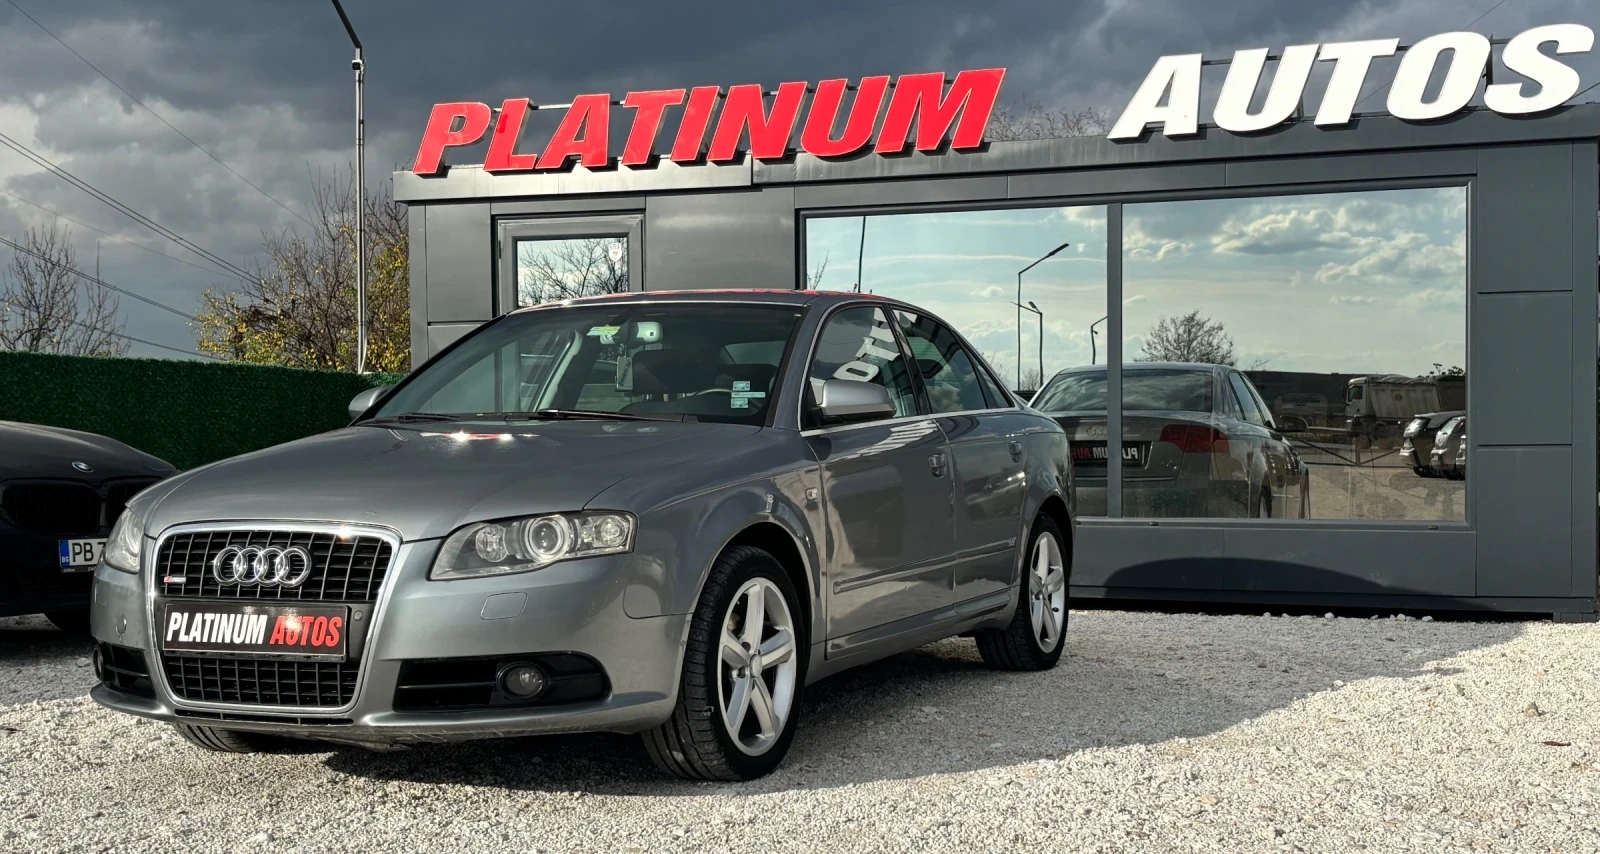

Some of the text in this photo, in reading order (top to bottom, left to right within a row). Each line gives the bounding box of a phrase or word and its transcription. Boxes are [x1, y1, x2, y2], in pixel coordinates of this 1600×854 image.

[413, 23, 1595, 174] PLATINUM AUTOS
[72, 542, 94, 563] PB
[166, 612, 342, 647] PLATINUM AUTOS
